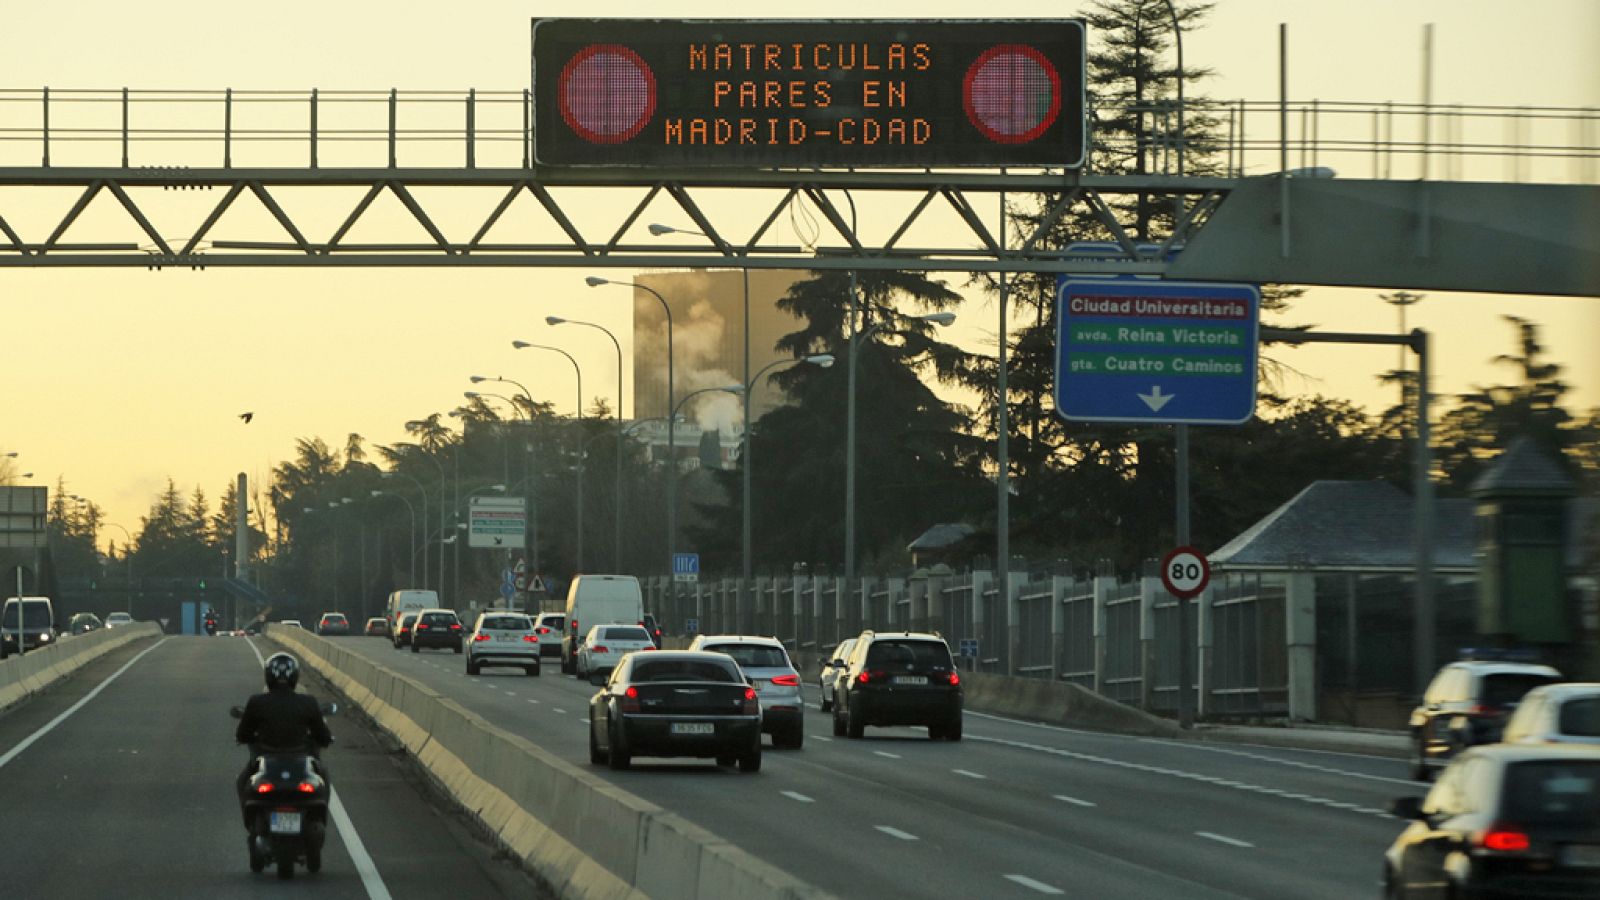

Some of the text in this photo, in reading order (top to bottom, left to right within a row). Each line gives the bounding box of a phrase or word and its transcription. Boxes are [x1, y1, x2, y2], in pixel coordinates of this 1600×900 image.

[689, 43, 932, 70] MATRICULAS
[714, 81, 907, 107] PARES EN
[665, 119, 932, 145] MADRID-CDAD
[1071, 299, 1245, 316] Ciudad Universitaria
[1077, 328, 1239, 345] avda. Reina Victoria
[1071, 356, 1242, 374] gta. Cuatro Caminos
[1172, 563, 1199, 580] 80
